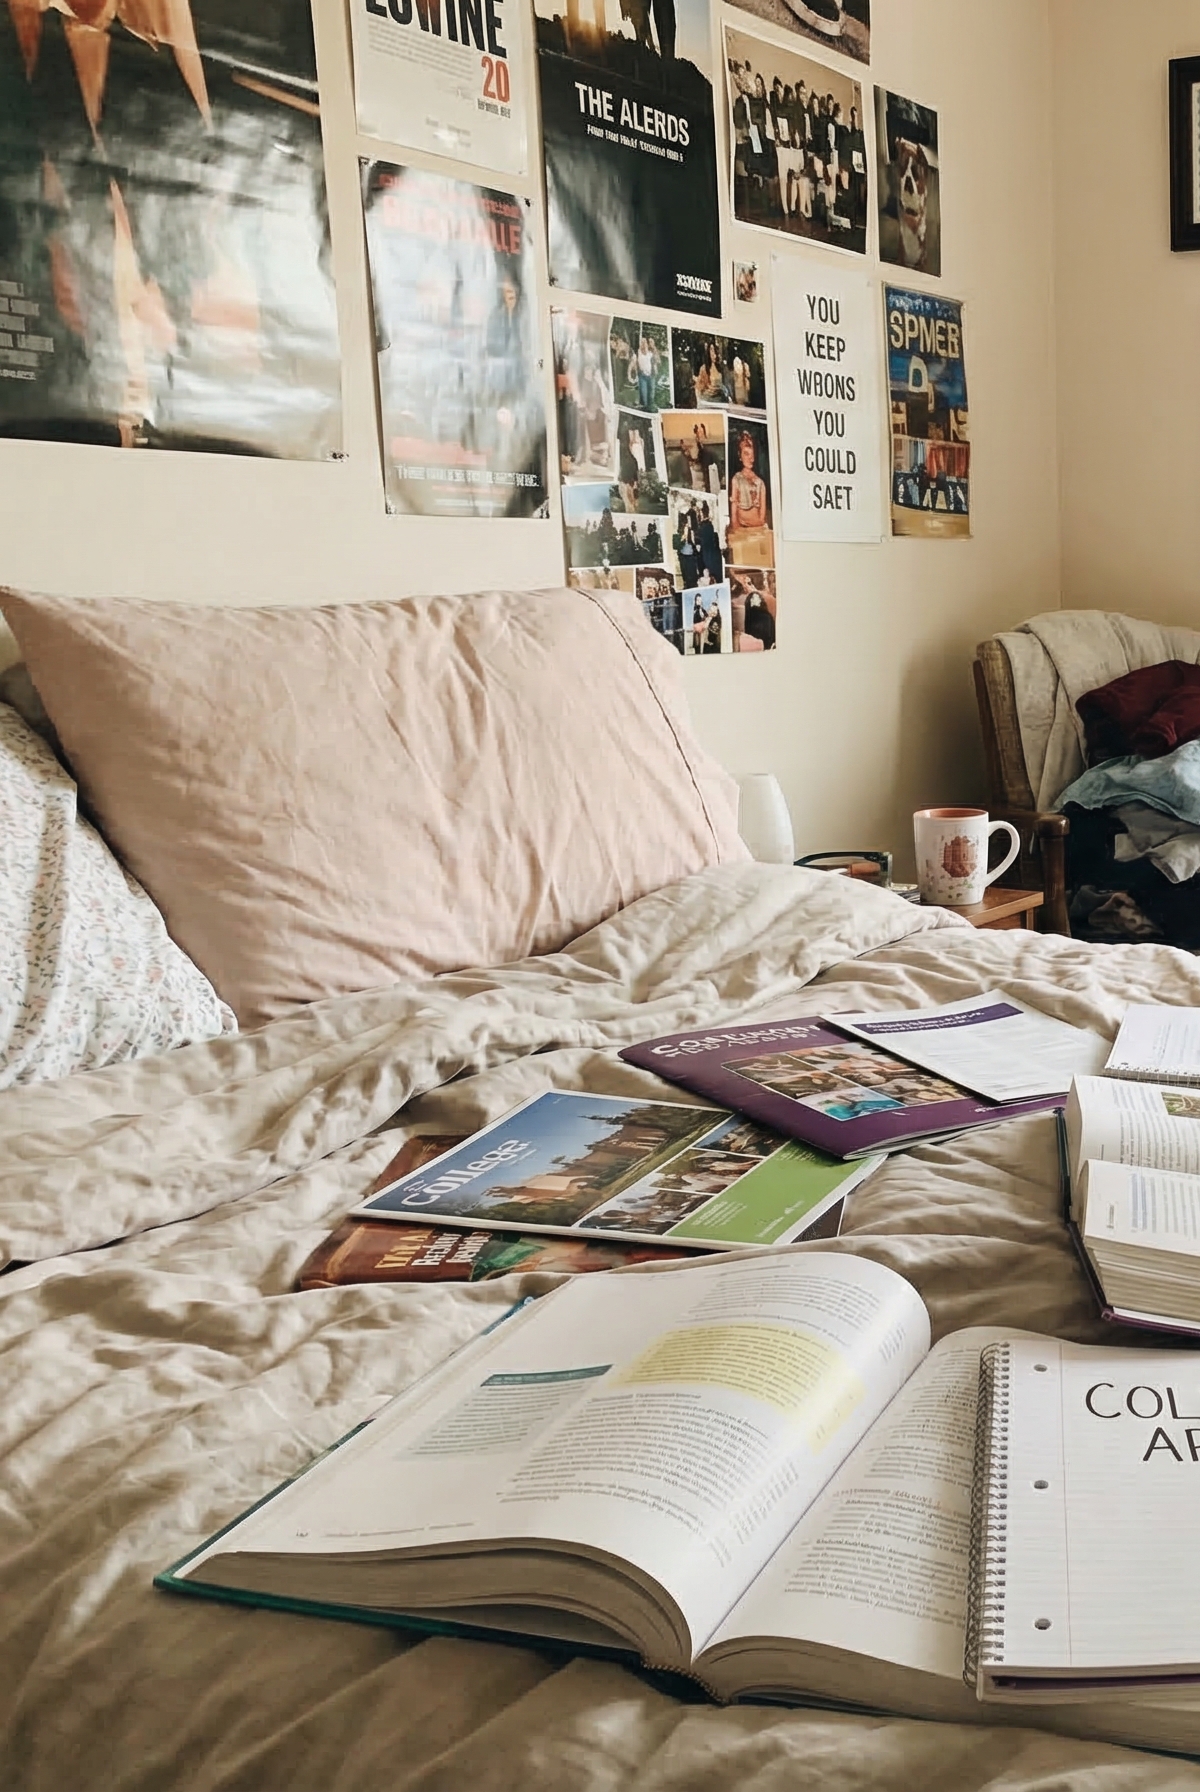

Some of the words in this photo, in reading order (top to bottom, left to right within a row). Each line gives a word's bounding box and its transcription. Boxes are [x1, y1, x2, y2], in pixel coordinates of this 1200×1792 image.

[366, 0, 507, 58] WINE
[481, 55, 510, 103] 20
[574, 81, 615, 123] THE
[806, 294, 840, 325] YOU
[805, 331, 846, 362] KEEP
[813, 409, 845, 438] YOU
[804, 446, 857, 475] COULD
[812, 483, 853, 511] SAET
